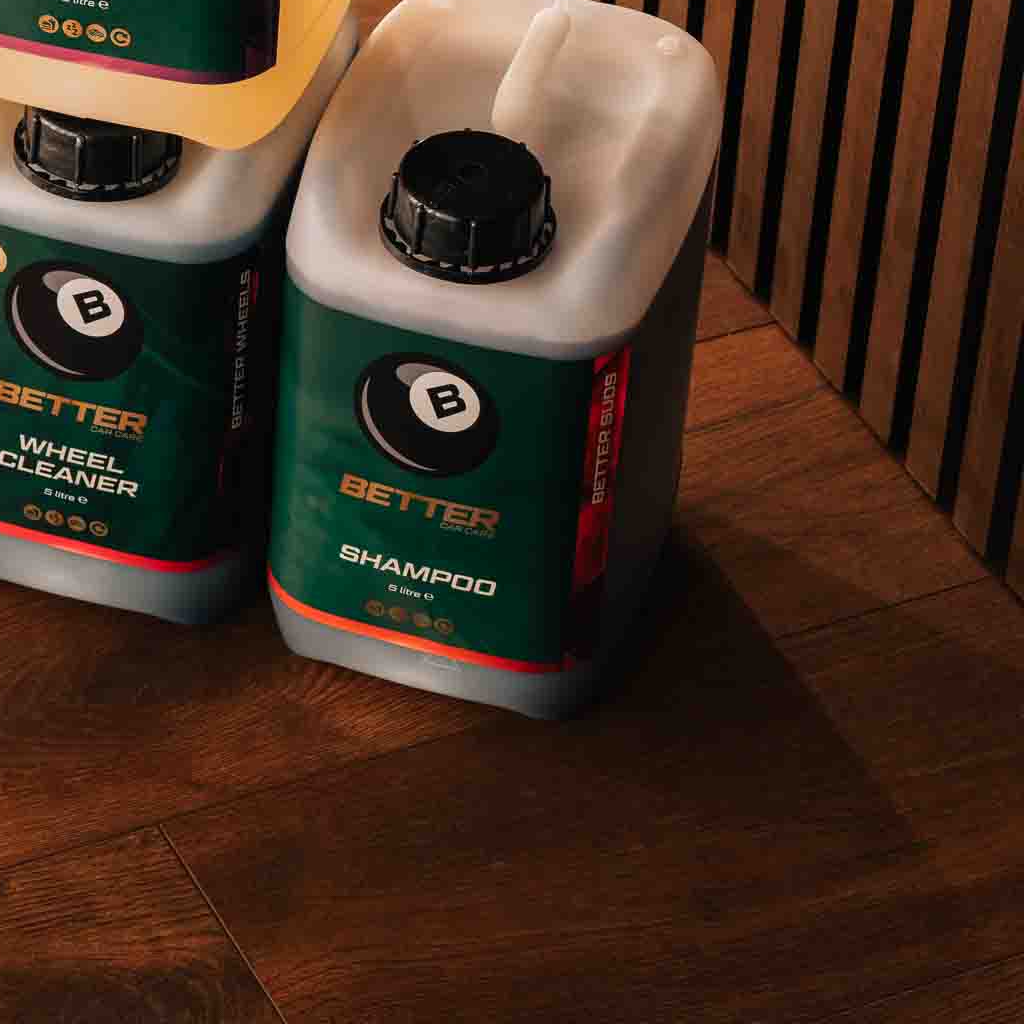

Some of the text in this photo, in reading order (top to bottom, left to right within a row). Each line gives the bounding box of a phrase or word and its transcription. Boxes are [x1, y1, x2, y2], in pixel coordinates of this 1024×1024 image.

[72, 289, 112, 324] B
[232, 270, 250, 429] BETTER WHEELS
[426, 383, 466, 419] B
[19, 433, 125, 474] WHEEL
[592, 372, 616, 504] BETTER SUDS
[43, 487, 53, 496] 5
[55, 490, 75, 502] litre
[339, 473, 501, 528] BETTER
[339, 544, 496, 596] SHAMPOO
[388, 584, 397, 592] 5
[399, 586, 421, 599] litre
